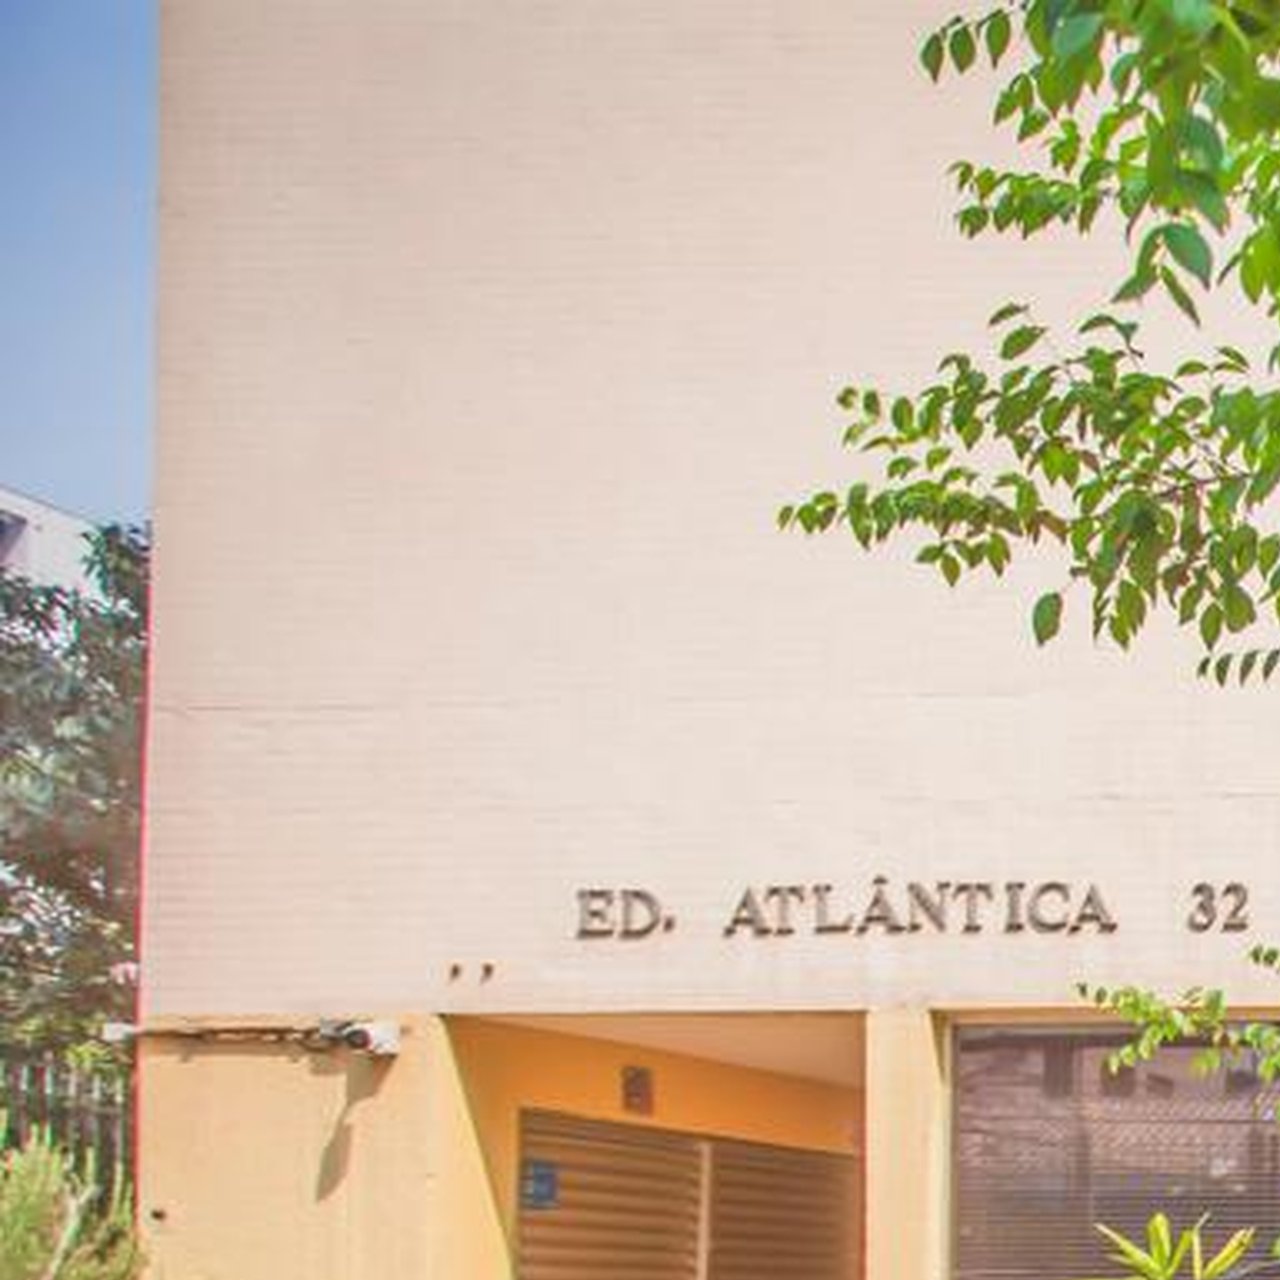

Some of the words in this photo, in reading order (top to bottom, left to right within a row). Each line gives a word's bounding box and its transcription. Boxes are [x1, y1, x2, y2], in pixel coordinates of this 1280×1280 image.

[576, 889, 676, 939] ED.
[722, 875, 1117, 936] ATLÂNTICA
[1186, 882, 1249, 933] 32
